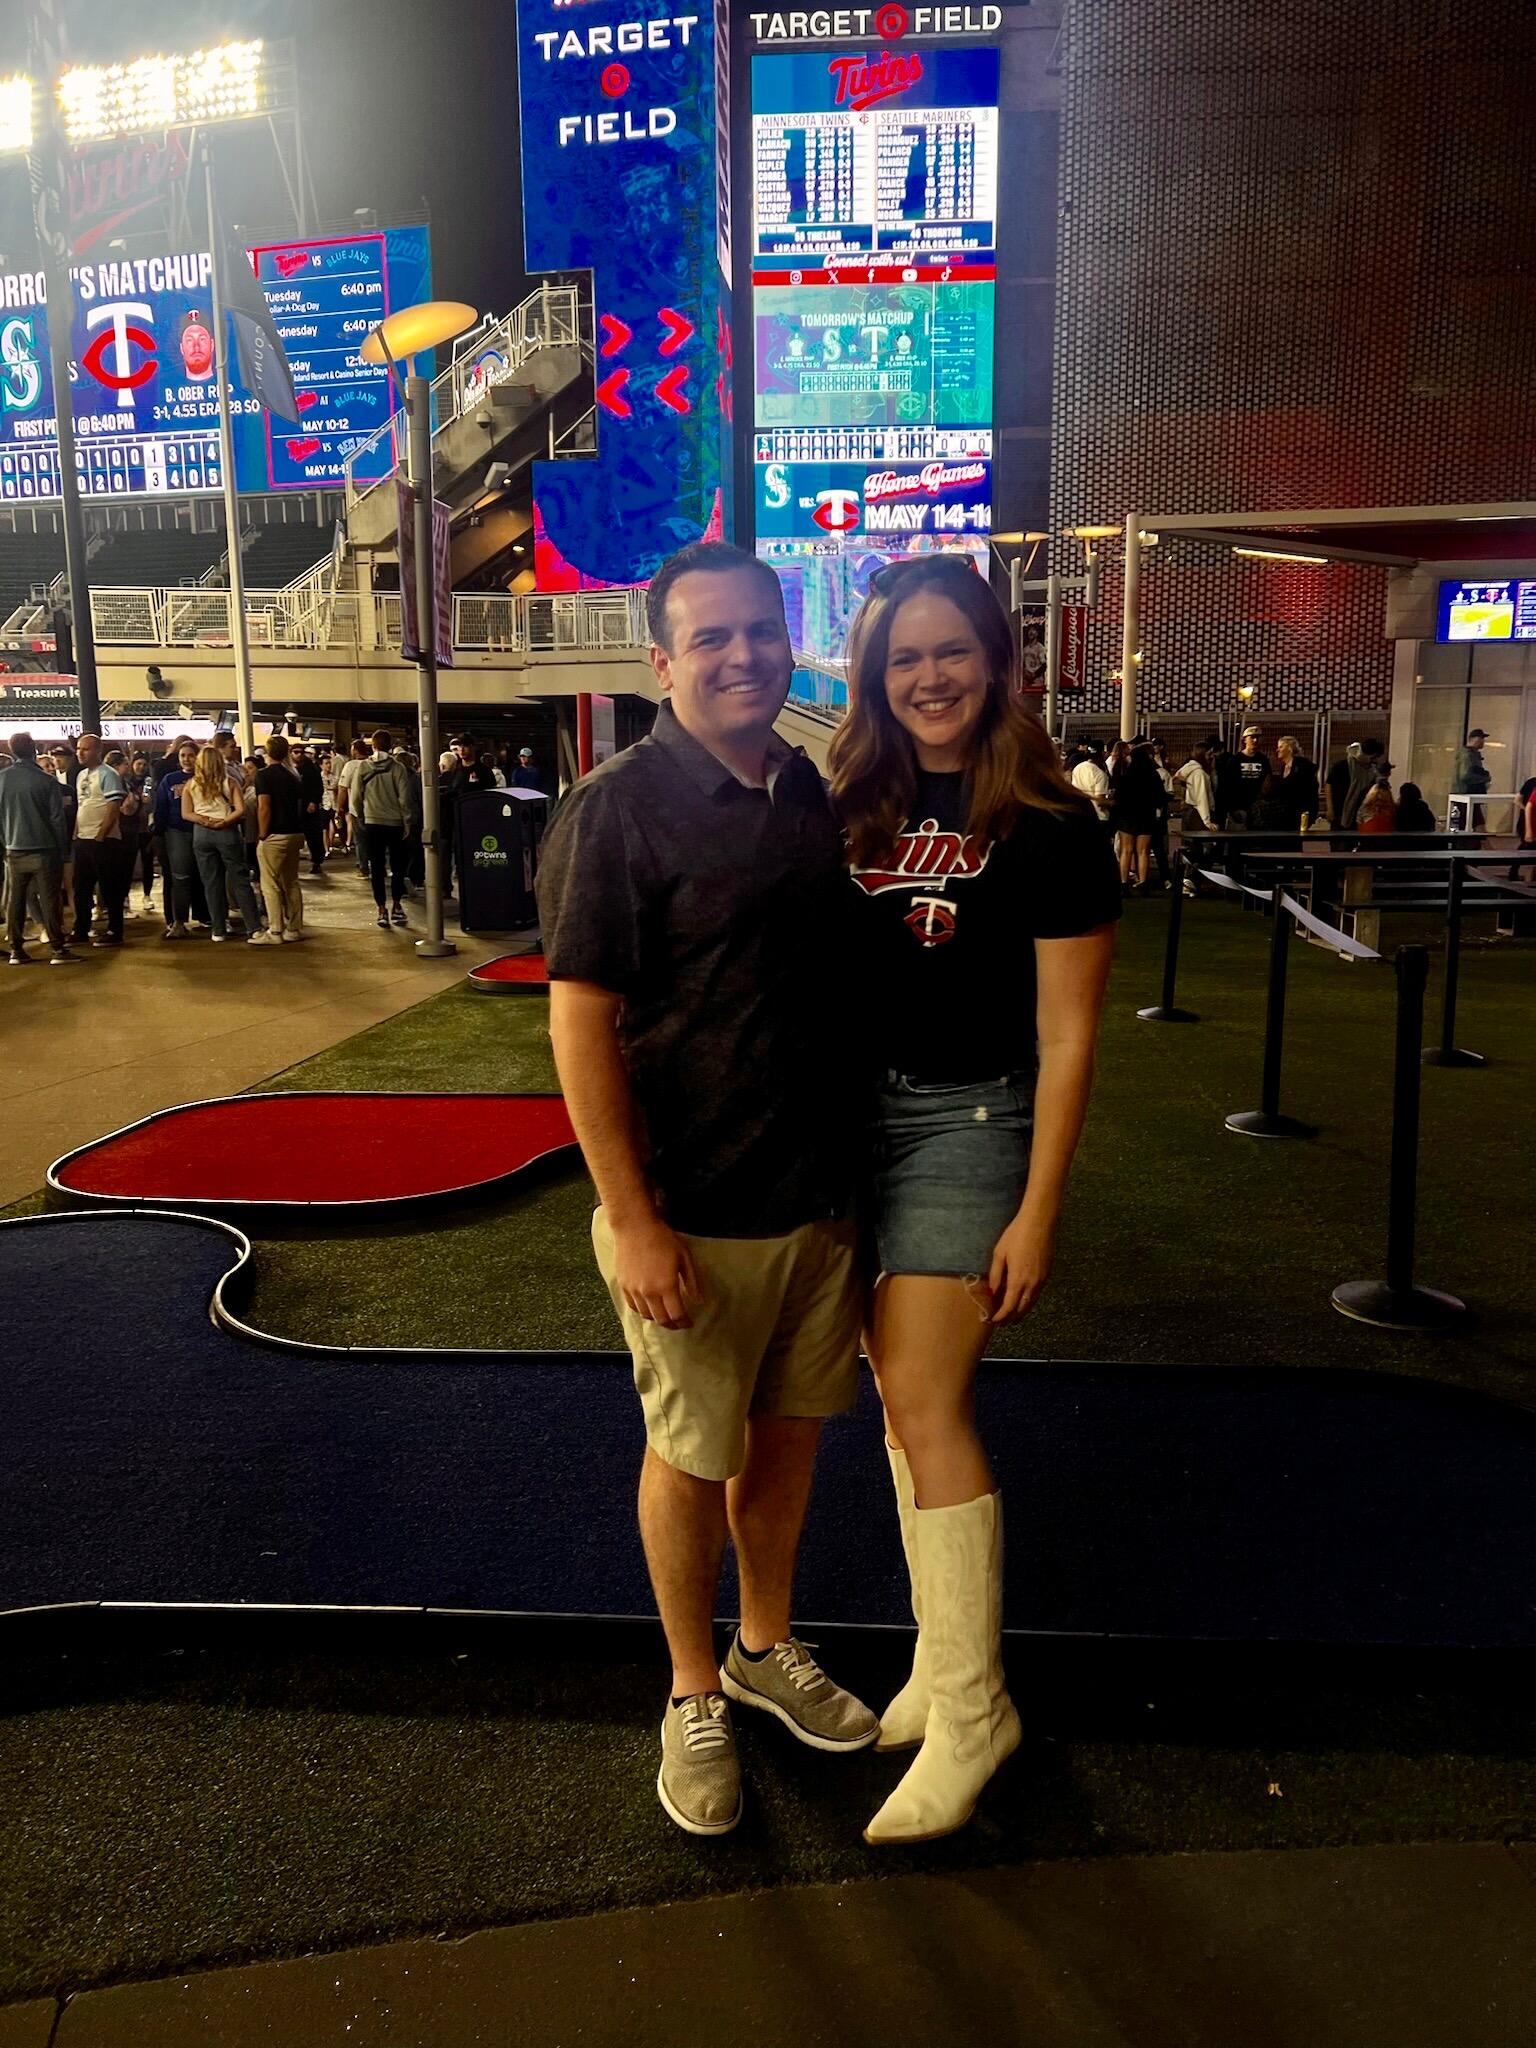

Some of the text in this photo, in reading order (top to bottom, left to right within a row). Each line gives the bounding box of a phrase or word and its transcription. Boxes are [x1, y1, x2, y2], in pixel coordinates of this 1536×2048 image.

[750, 5, 1002, 39] TARGET FIELD
[534, 16, 699, 62] TARGET
[828, 50, 923, 112] Twins
[761, 115, 817, 127] MINNESOTA
[820, 114, 850, 126] TWINS
[881, 111, 972, 124] SEATTLE MARINERS
[558, 107, 677, 147] FIELD
[312, 255, 322, 267] VS
[326, 250, 347, 268] BLUE
[348, 250, 370, 264] JAYS
[823, 250, 916, 269] Connect with us!
[99, 252, 213, 298] MATCHUP
[264, 283, 382, 304] Tuesday 6:40 pm
[269, 302, 320, 314] ollar-A-Dog Day
[801, 313, 866, 327] TOMORROW'S
[867, 312, 914, 325] MATCHUP
[276, 324, 318, 338] dnesday
[342, 320, 366, 332] 6:40
[288, 360, 310, 372] sday
[311, 370, 330, 381] Resort
[335, 368, 354, 379] Casino
[355, 368, 373, 378] Senior
[373, 368, 388, 376] Days
[165, 384, 234, 402] B. OBER RP
[320, 396, 329, 406] AT
[334, 392, 355, 408] BLUE
[356, 390, 377, 406] JAYS
[153, 406, 170, 420] 3-1,
[172, 403, 198, 418] 4.55
[244, 399, 260, 413] SO
[14, 418, 44, 438] FIRST
[117, 412, 136, 430] PM
[302, 418, 349, 432] MAY 10-12
[322, 442, 332, 452] VS
[4, 444, 216, 473] 0 0 0 0 1 0 0 1 3 1 4
[305, 464, 326, 476] MAY
[921, 462, 986, 496] Games
[6, 468, 217, 496] 0 0 0 0 2 0 3 4 0 5
[864, 504, 929, 529] MAY
[13, 686, 67, 698] Treasure
[132, 724, 165, 736] TWINS
